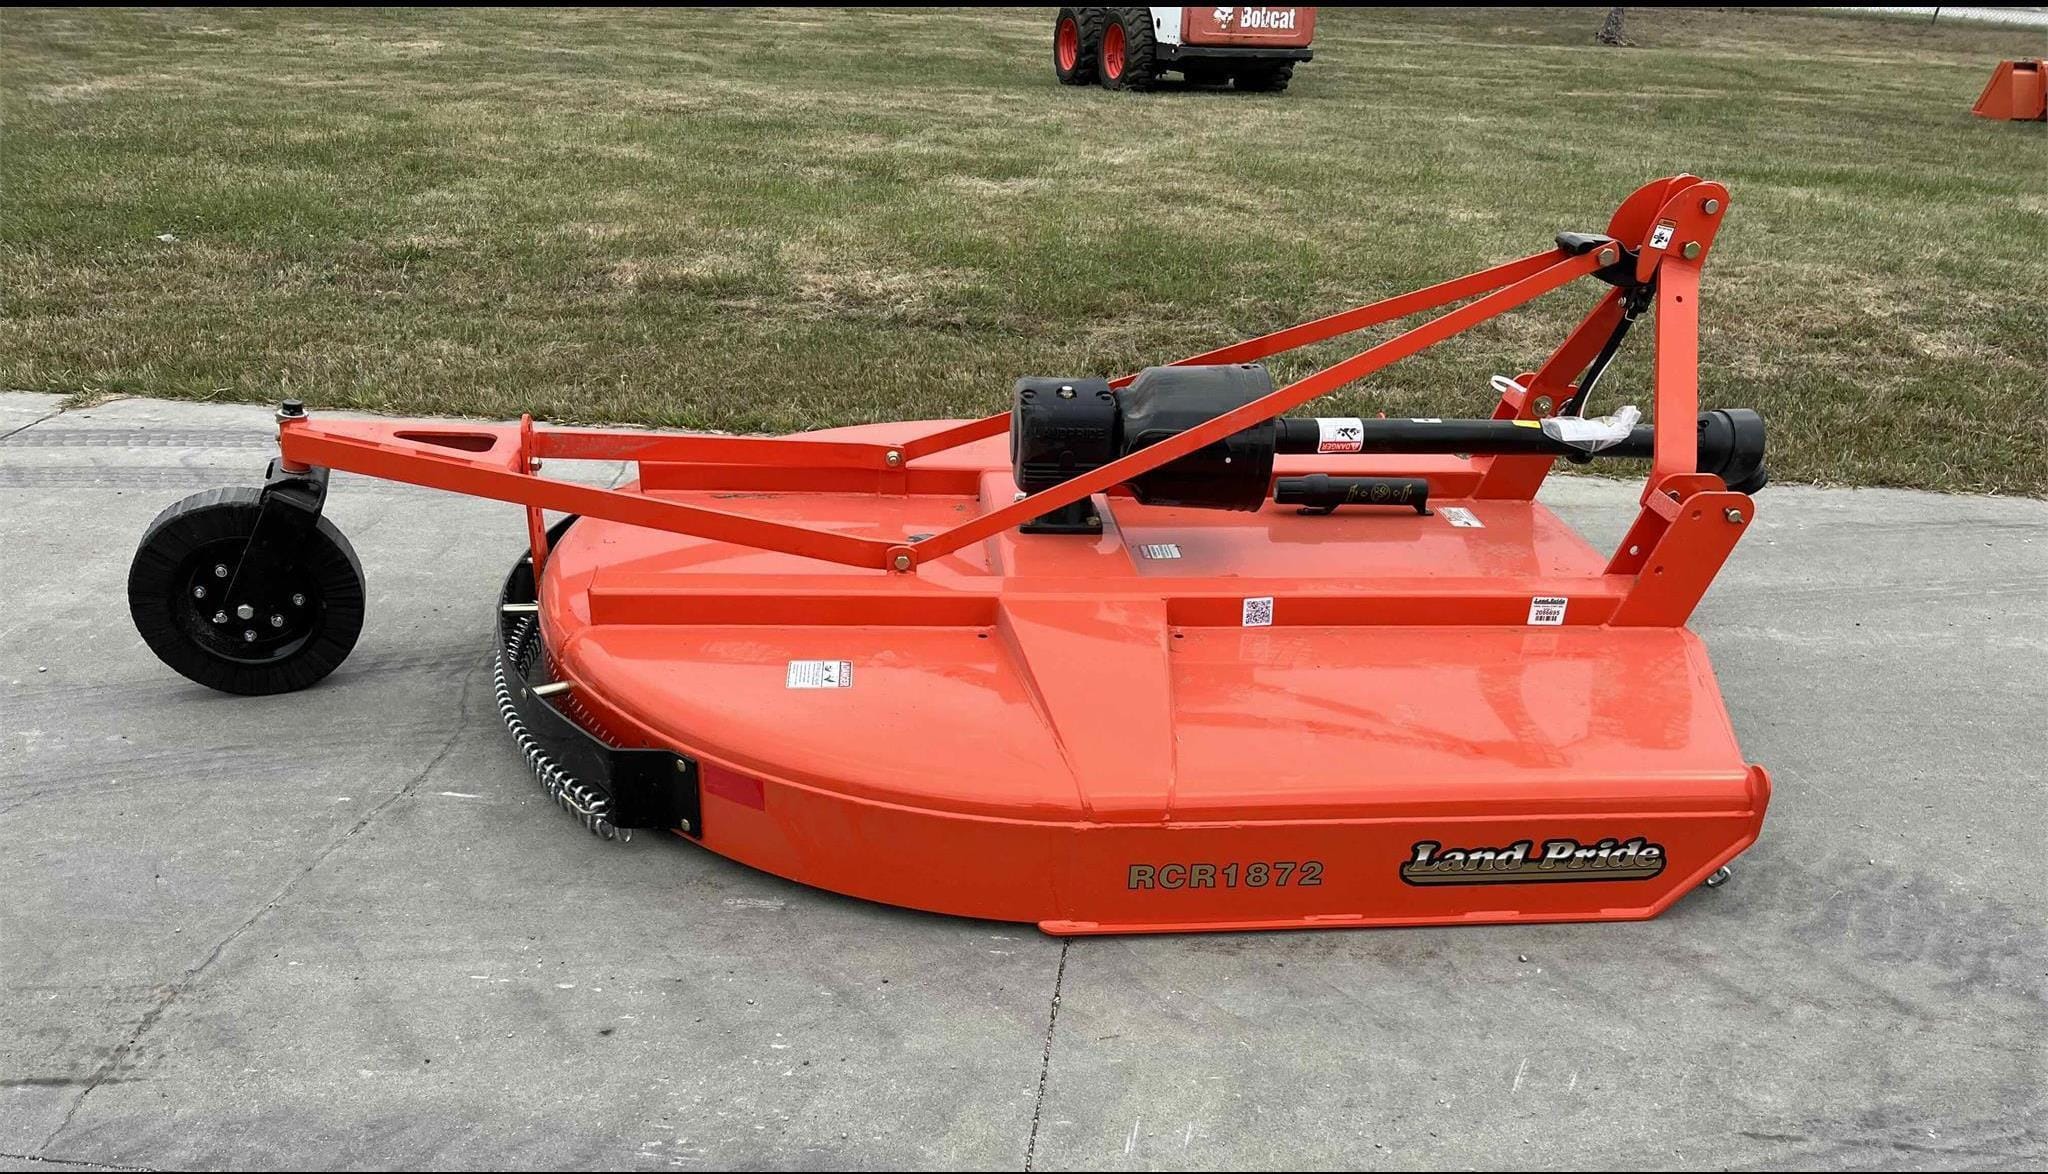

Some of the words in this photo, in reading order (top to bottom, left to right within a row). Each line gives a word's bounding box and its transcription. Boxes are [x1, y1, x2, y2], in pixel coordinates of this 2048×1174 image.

[1240, 7, 1296, 29] Bobcat
[1408, 843, 1529, 872] Land
[1538, 840, 1661, 869] Pride
[1128, 861, 1324, 890] RCR1872
